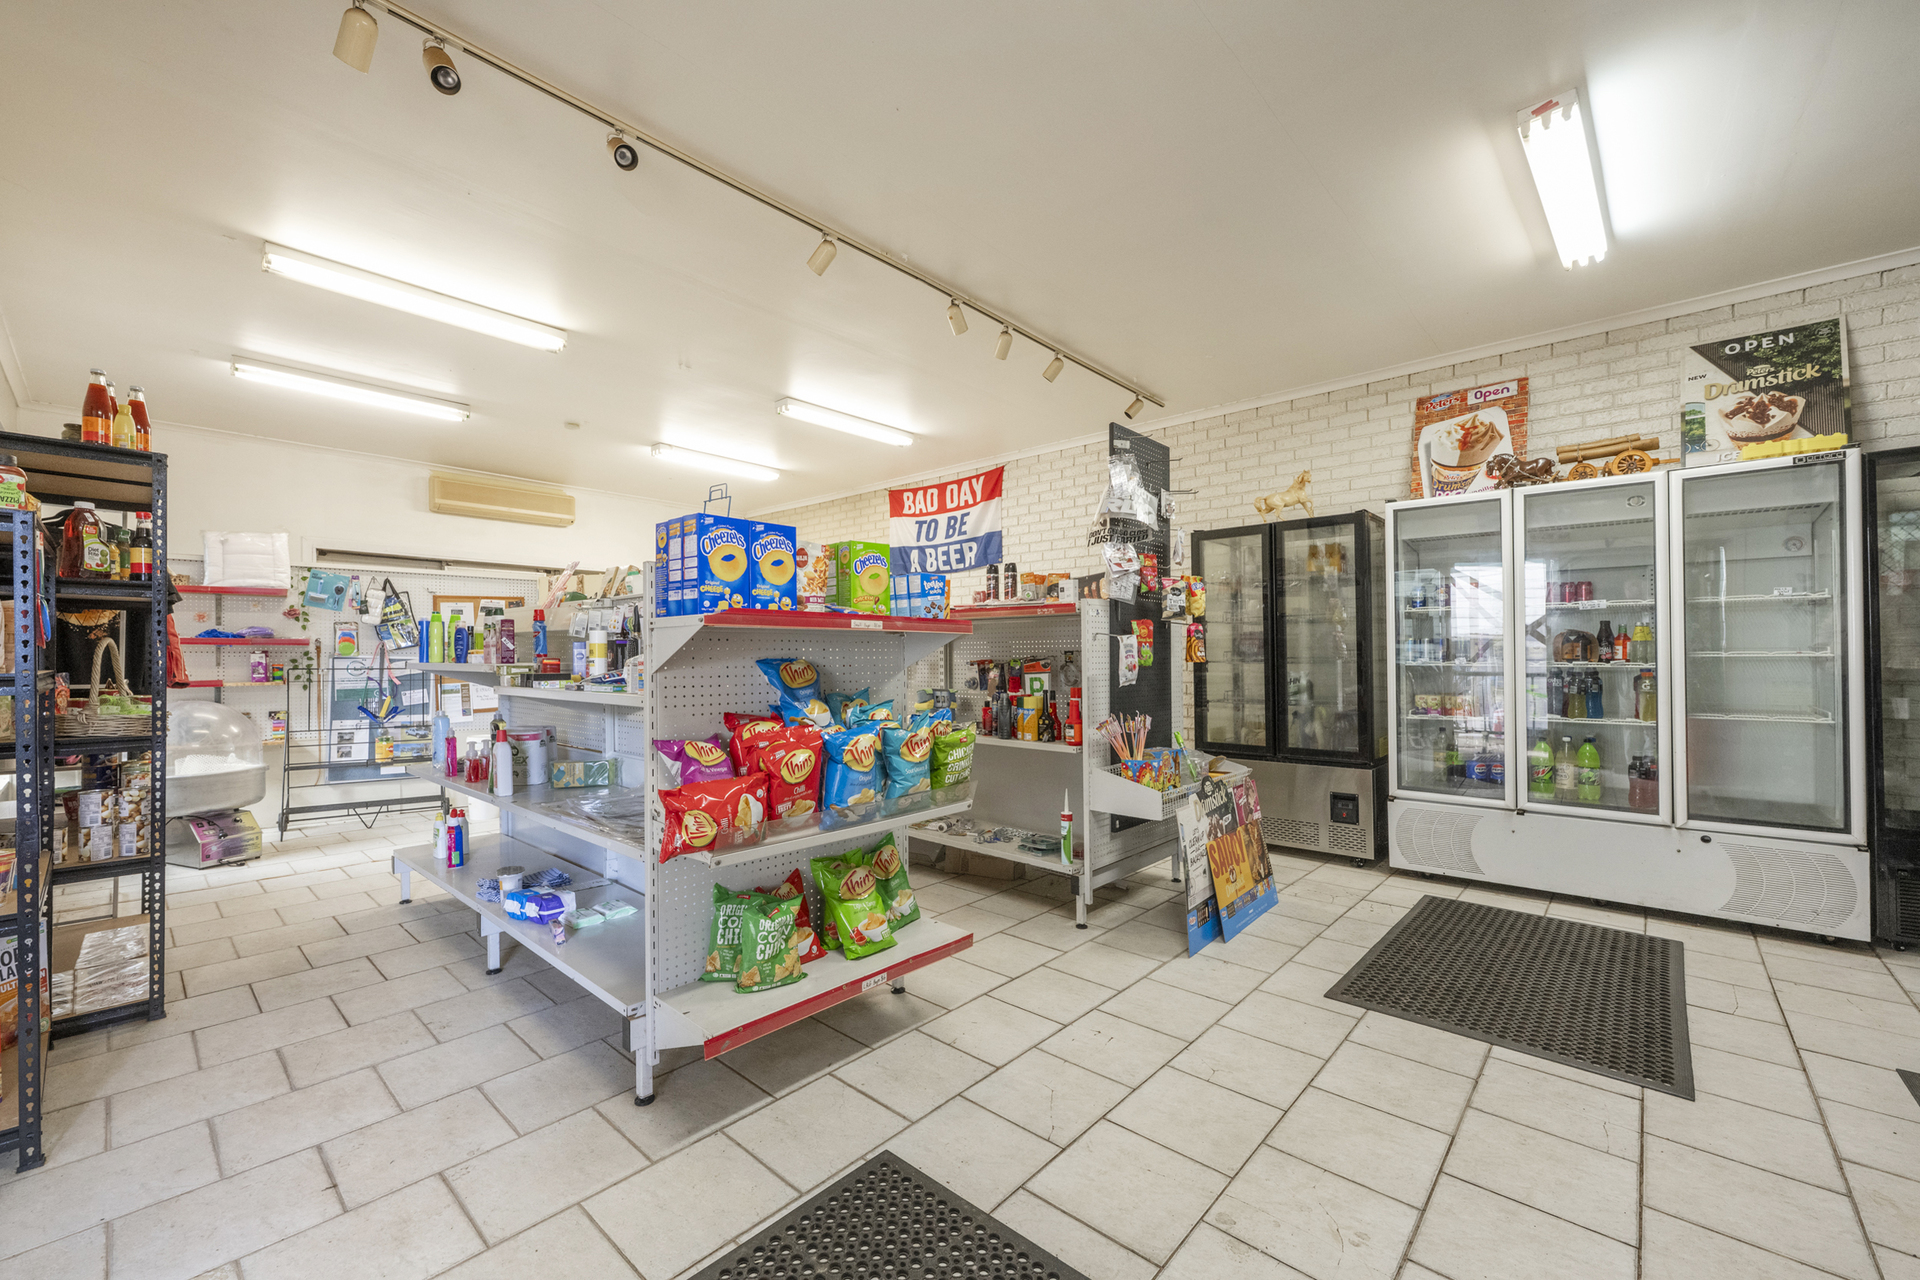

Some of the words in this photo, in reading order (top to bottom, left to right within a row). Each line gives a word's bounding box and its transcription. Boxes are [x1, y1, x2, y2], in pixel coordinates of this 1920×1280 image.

[1724, 332, 1794, 355] OPEN
[1687, 374, 1708, 382] NEW
[1703, 363, 1822, 401] Drumstick
[1424, 396, 1460, 413] Peters
[1474, 386, 1510, 402] Open
[902, 488, 938, 515] BAD
[945, 475, 986, 510] DAY
[915, 518, 939, 543] TO
[944, 511, 971, 540] BE
[700, 529, 747, 557] Cheezels
[751, 536, 794, 562] Cheezels
[1090, 534, 1115, 547] JUST
[1115, 534, 1149, 545] FARTED
[853, 554, 888, 576] Cheezels
[910, 549, 922, 573] A
[924, 541, 978, 573] BEER
[700, 585, 723, 593] CHEESE
[751, 589, 773, 597] CHEESE
[780, 662, 814, 685] Thins
[845, 738, 876, 765] Thin
[781, 753, 813, 779] Thins
[794, 785, 806, 795] Chilli
[945, 774, 958, 784] CUT
[1193, 789, 1228, 822] Drumstick
[873, 849, 898, 874] Thins
[1208, 829, 1246, 879] SAUCY
[841, 869, 875, 896] Thins
